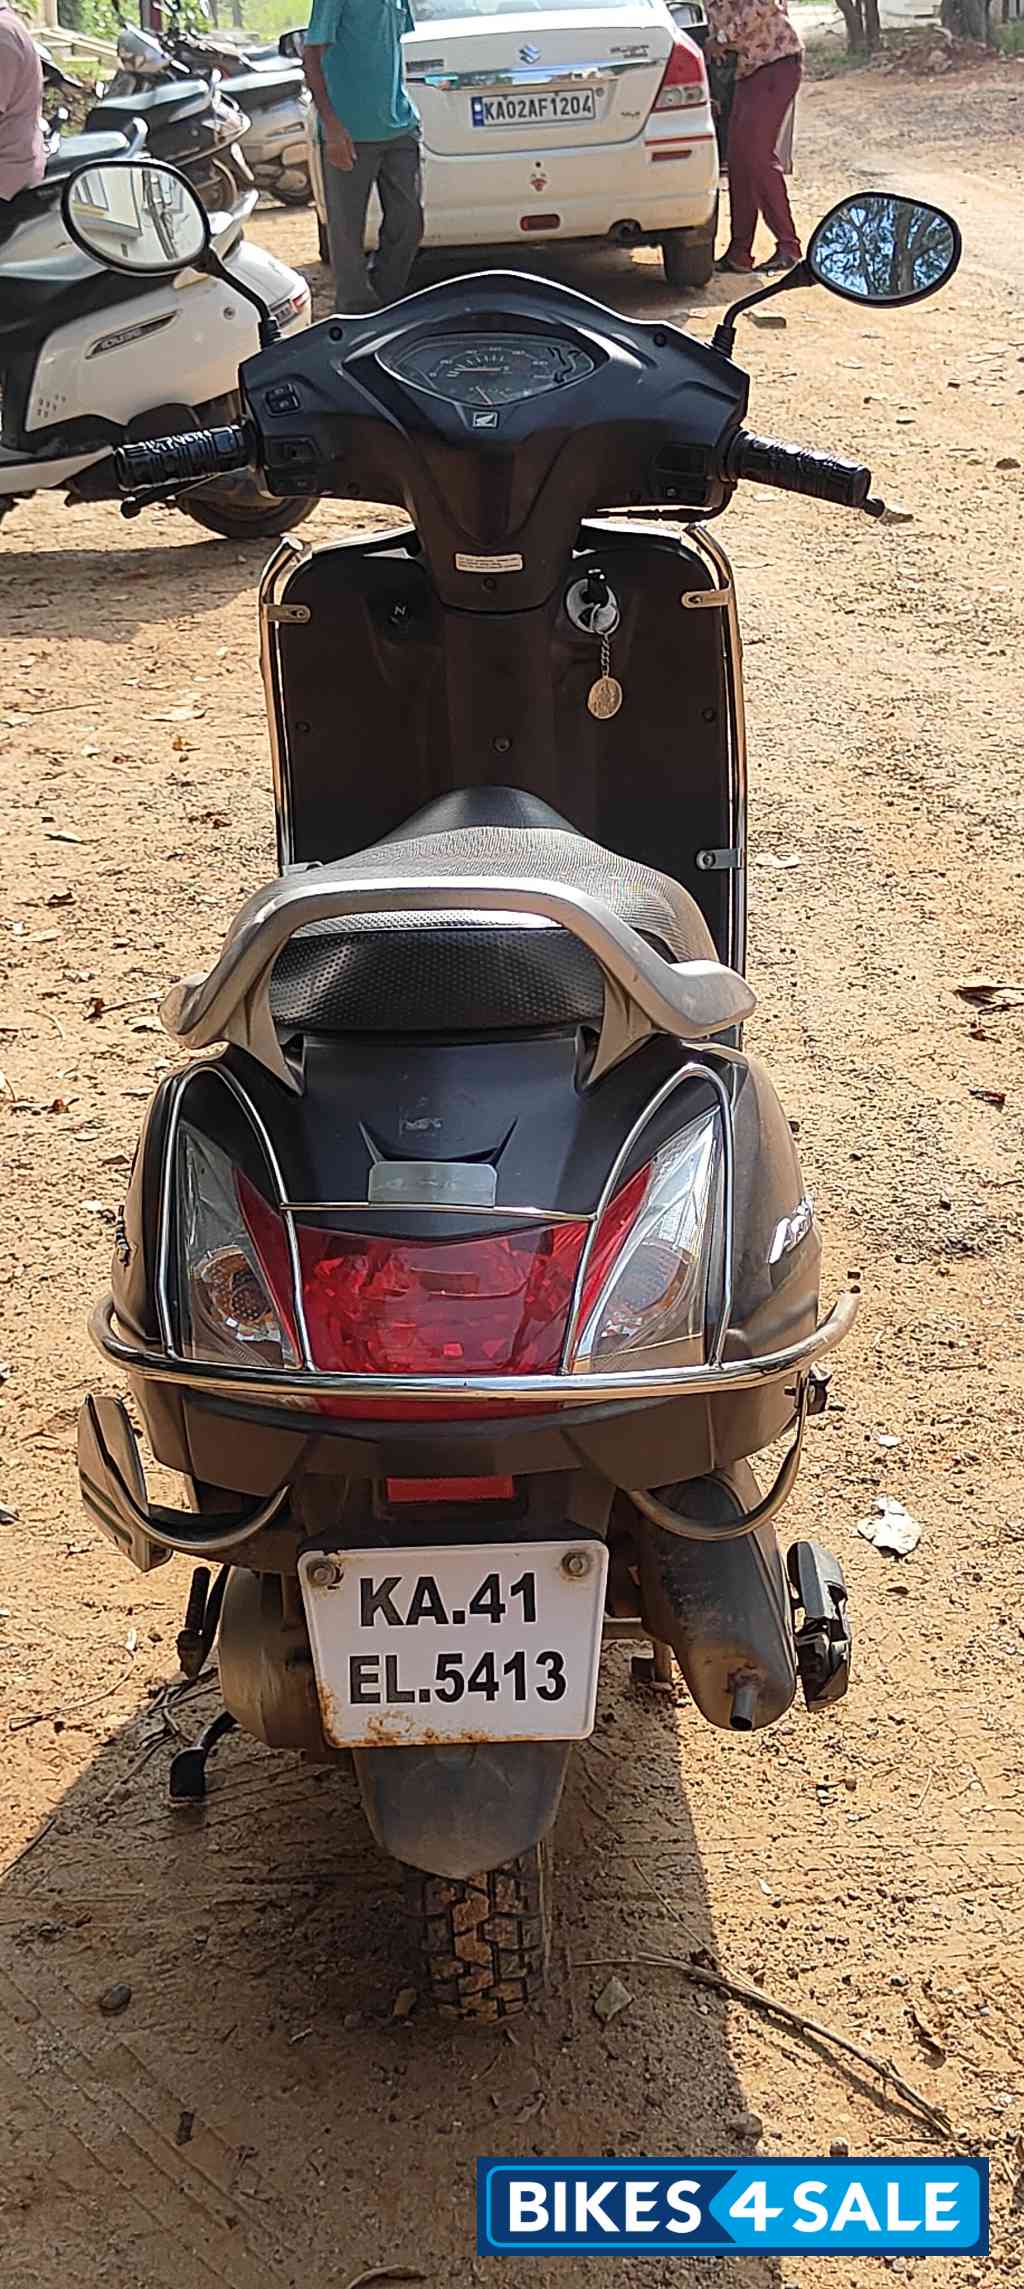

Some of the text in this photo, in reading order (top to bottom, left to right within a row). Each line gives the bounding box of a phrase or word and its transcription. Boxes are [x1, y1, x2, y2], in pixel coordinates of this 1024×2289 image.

[484, 95, 592, 121] KA02AF1204
[360, 1572, 537, 1627] KA.41
[349, 1650, 567, 1705] EL.5413
